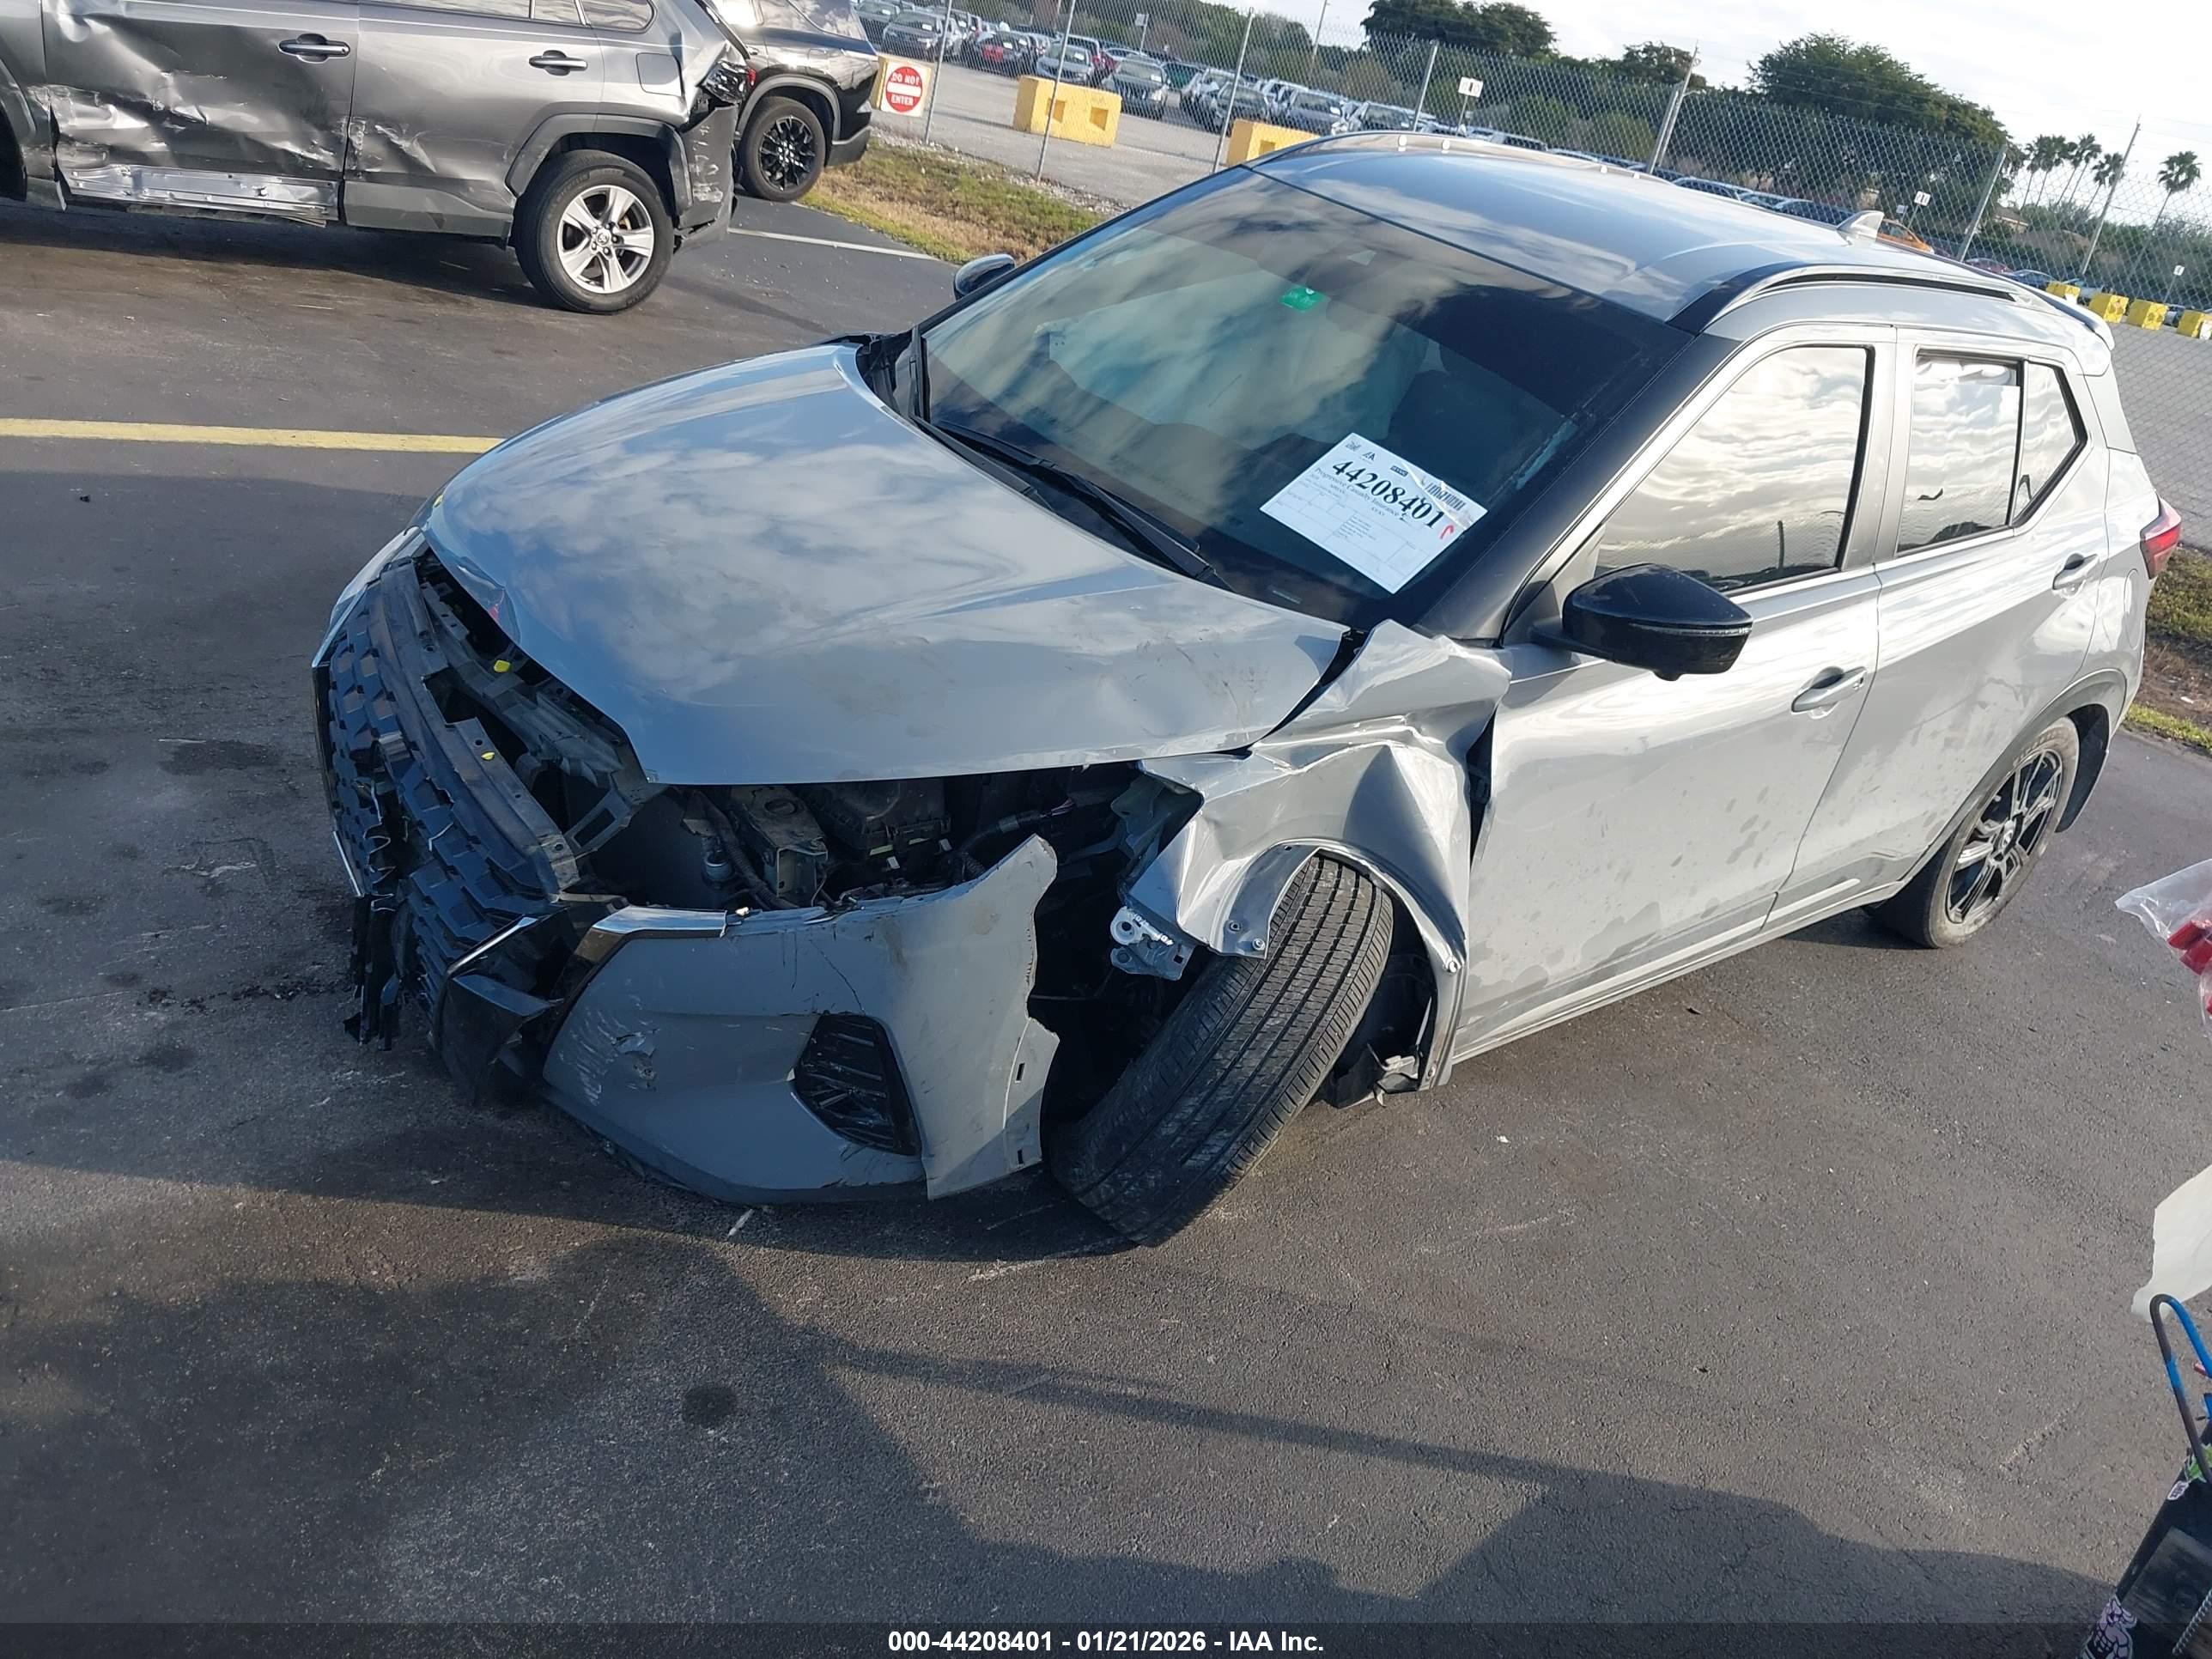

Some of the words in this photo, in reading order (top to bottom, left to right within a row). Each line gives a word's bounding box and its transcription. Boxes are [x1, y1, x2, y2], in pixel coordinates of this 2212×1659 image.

[891, 72, 902, 82] DO
[904, 75, 920, 85] NOT
[890, 94, 914, 106] ENTER
[1332, 460, 1446, 529] 44208401
